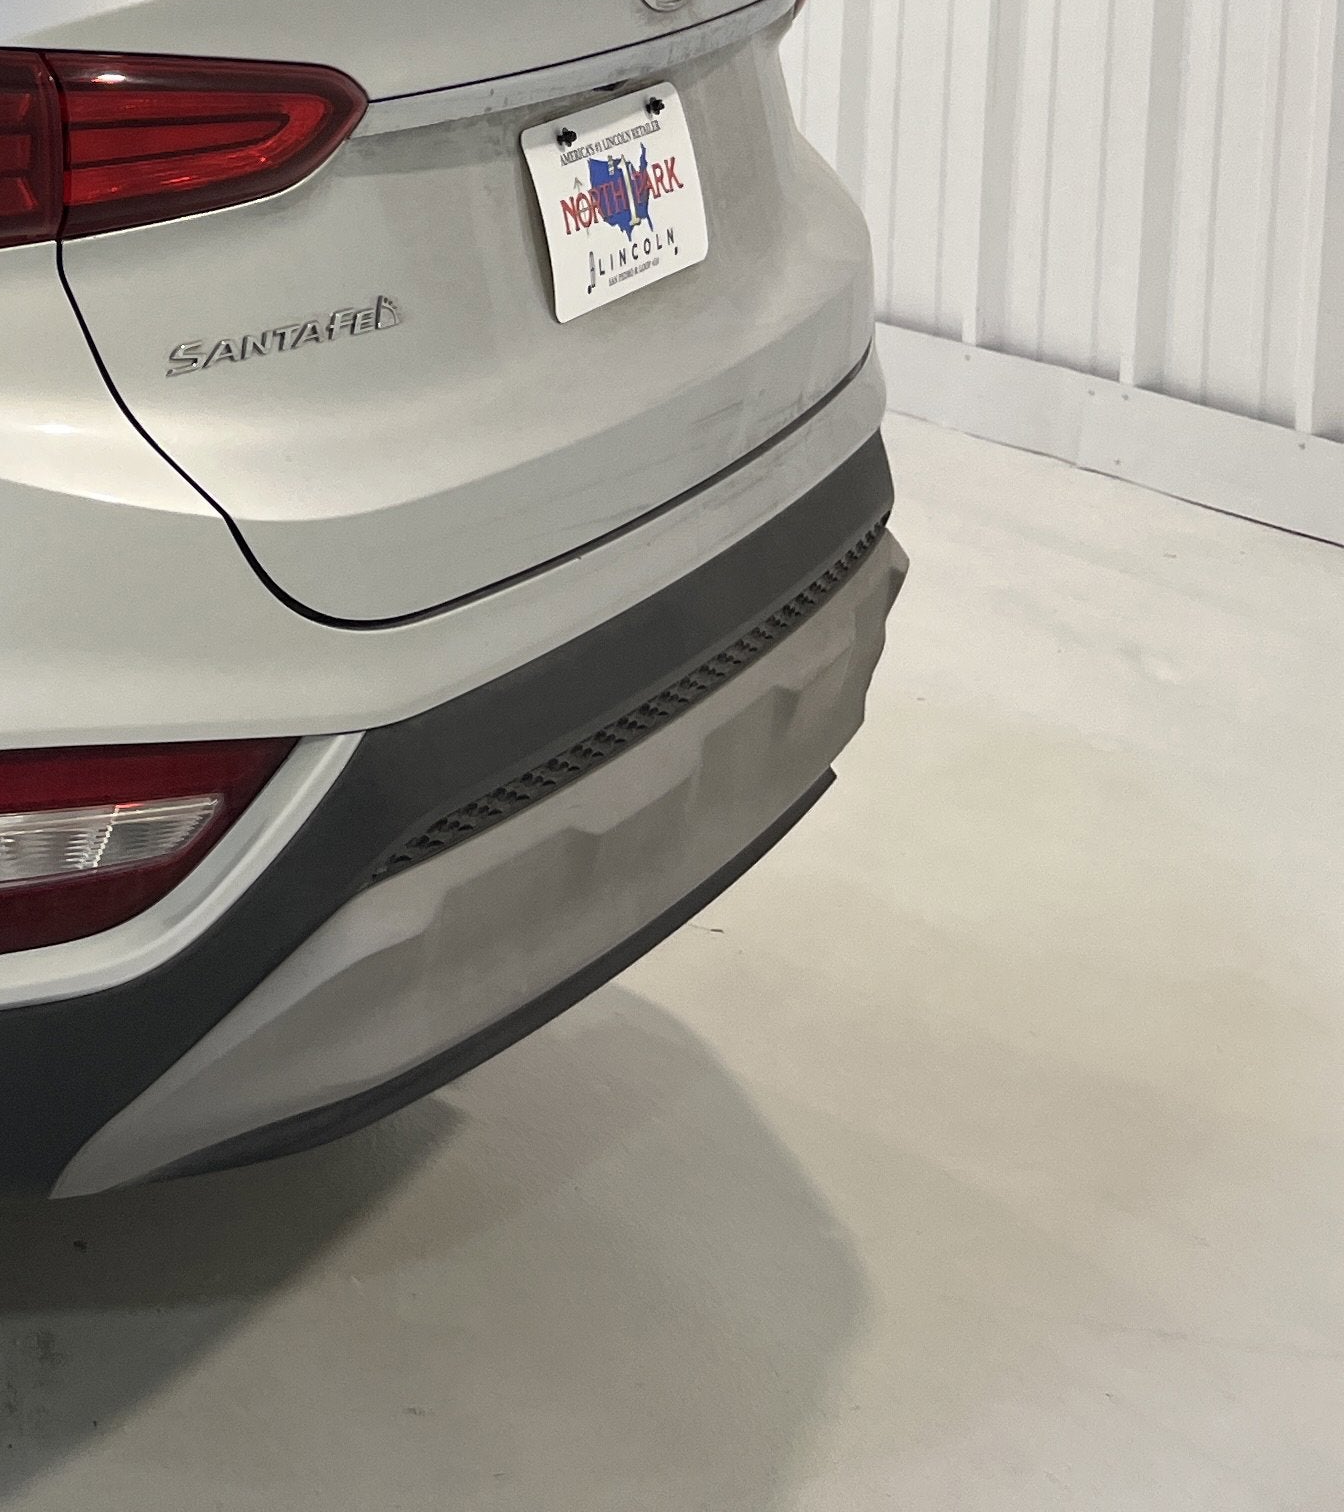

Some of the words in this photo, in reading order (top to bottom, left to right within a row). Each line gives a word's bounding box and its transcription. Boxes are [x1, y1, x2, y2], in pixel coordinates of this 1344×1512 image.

[560, 178, 630, 235] NORTH
[631, 156, 684, 204] PARK
[598, 227, 675, 276] LINCOLN
